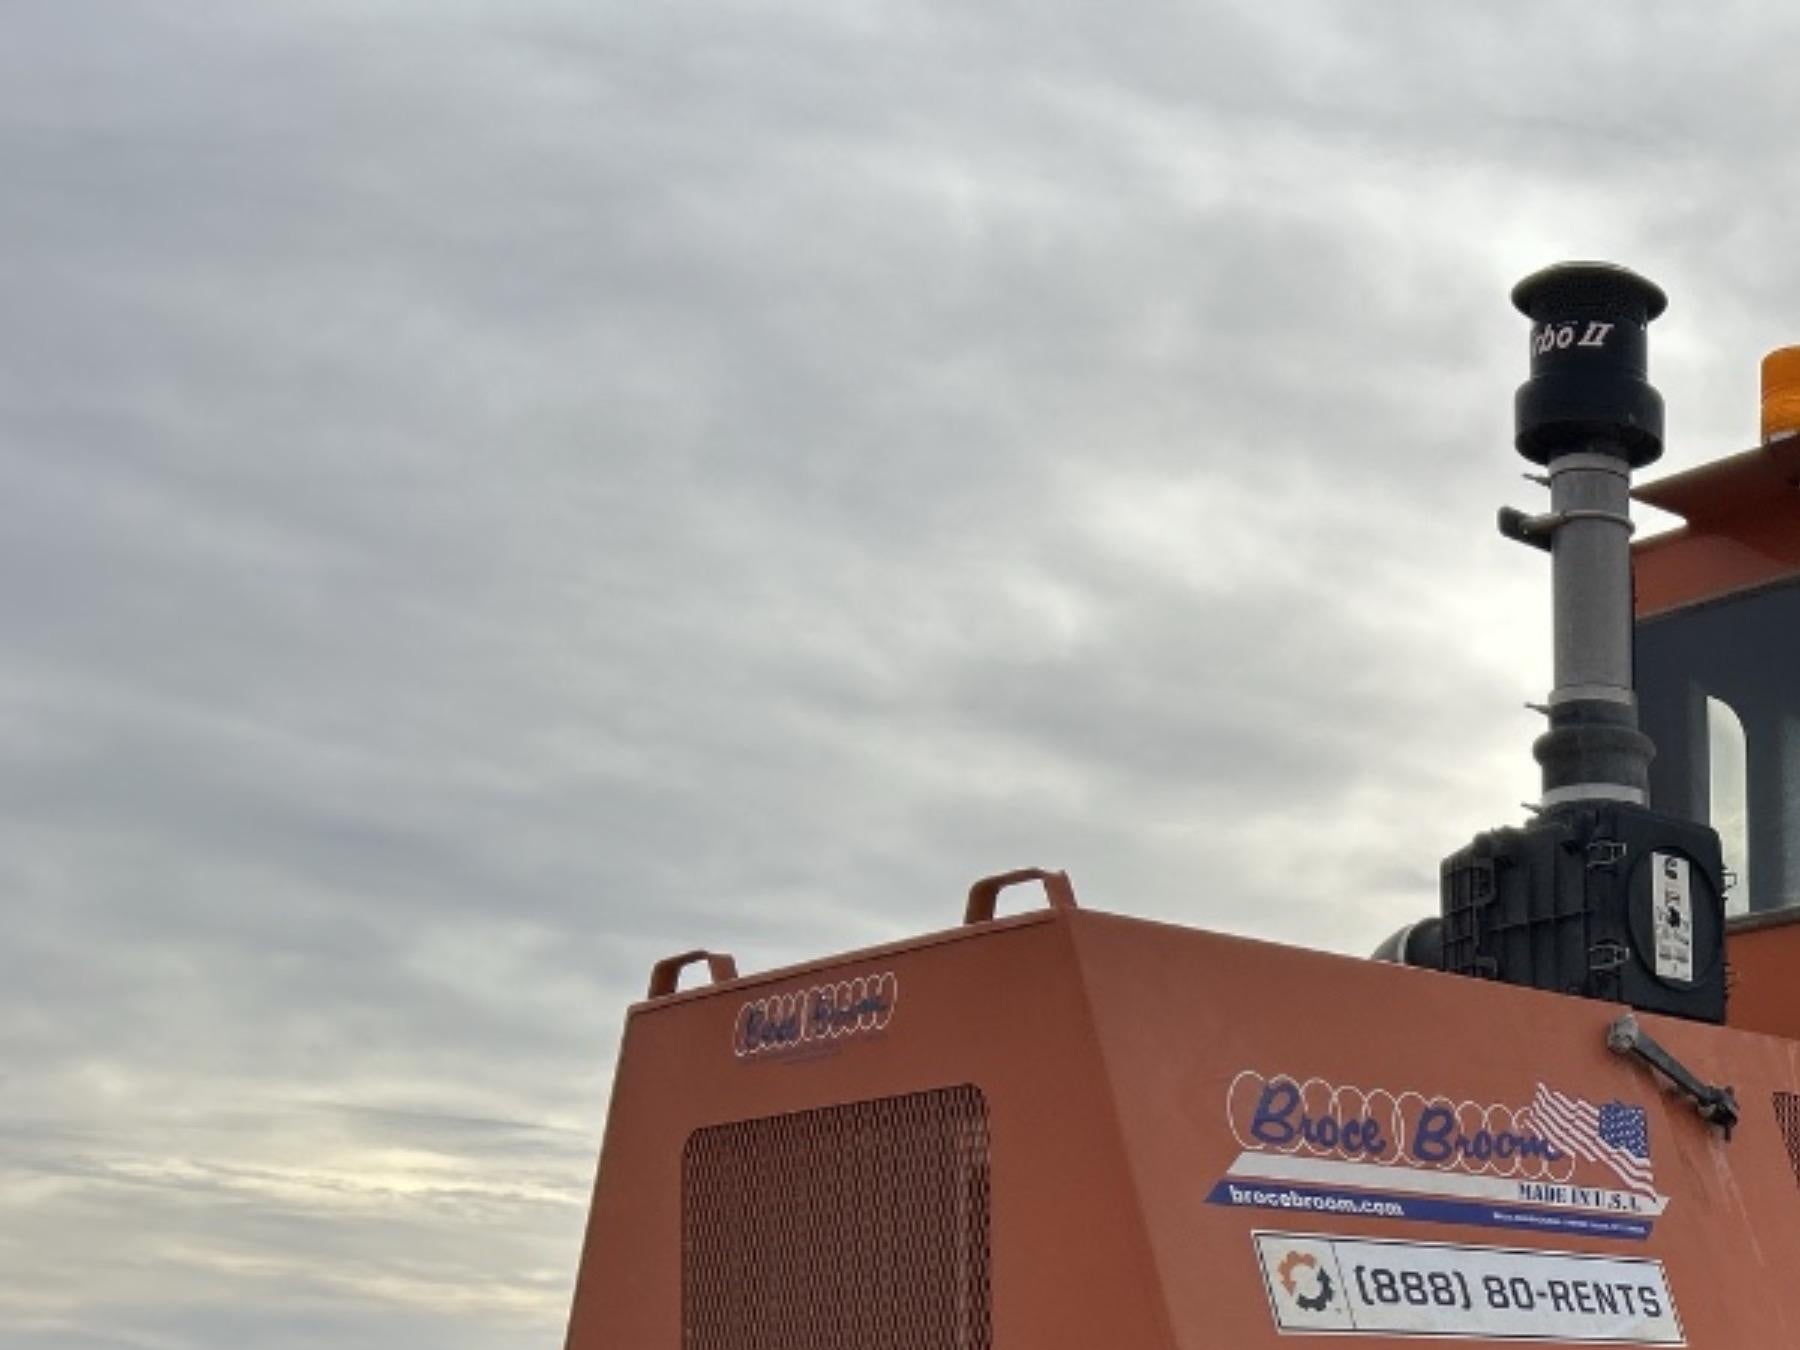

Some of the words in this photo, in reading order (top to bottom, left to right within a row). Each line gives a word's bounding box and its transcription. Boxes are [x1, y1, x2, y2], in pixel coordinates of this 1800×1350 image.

[1251, 1082, 1387, 1153] Broce
[1413, 1106, 1563, 1161] Broom
[1229, 1184, 1405, 1216] brocebroom.com
[1519, 1182, 1566, 1204] MADE
[1571, 1190, 1590, 1206] IN
[1353, 1265, 1471, 1310] (888)
[1482, 1275, 1662, 1317] 80-RENTS
